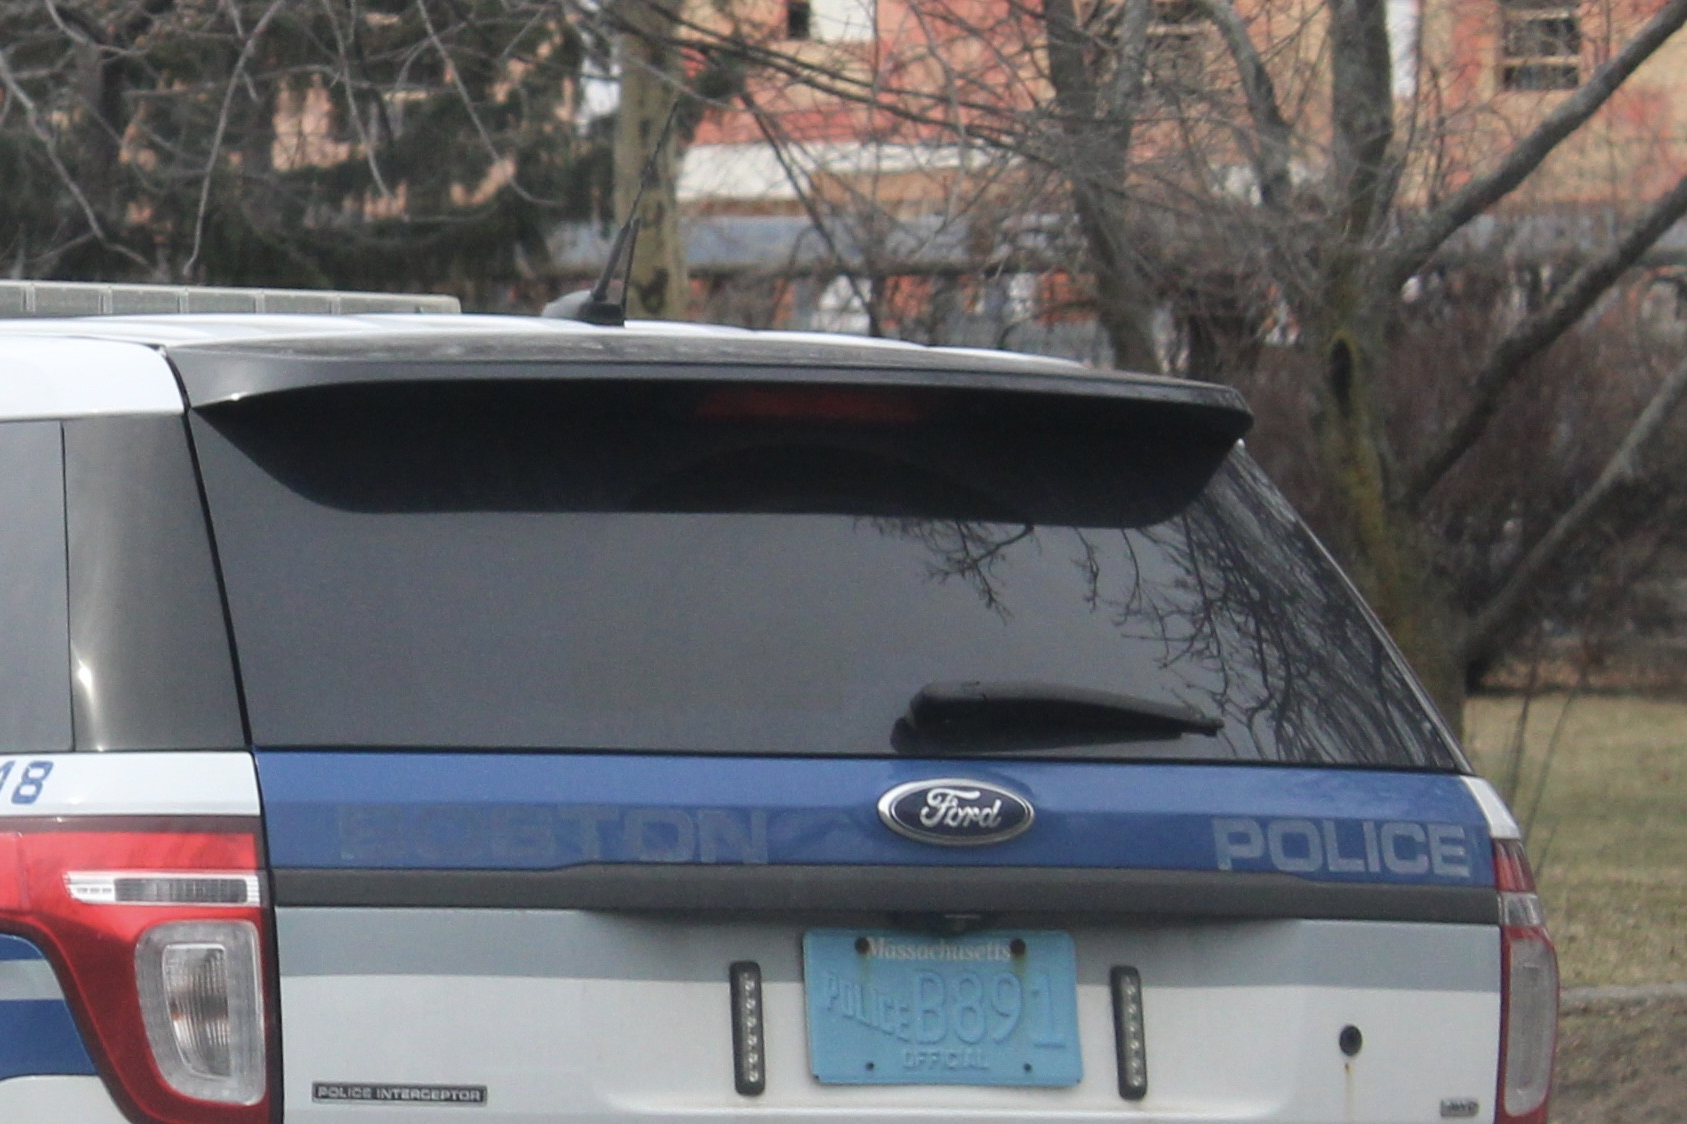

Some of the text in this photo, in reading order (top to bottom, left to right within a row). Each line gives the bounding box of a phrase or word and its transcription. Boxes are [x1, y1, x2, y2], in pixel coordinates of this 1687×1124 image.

[919, 787, 1003, 828] Ford
[1211, 816, 1471, 878] POLICE
[317, 1086, 482, 1102] POLICE INTERCEPTOR
